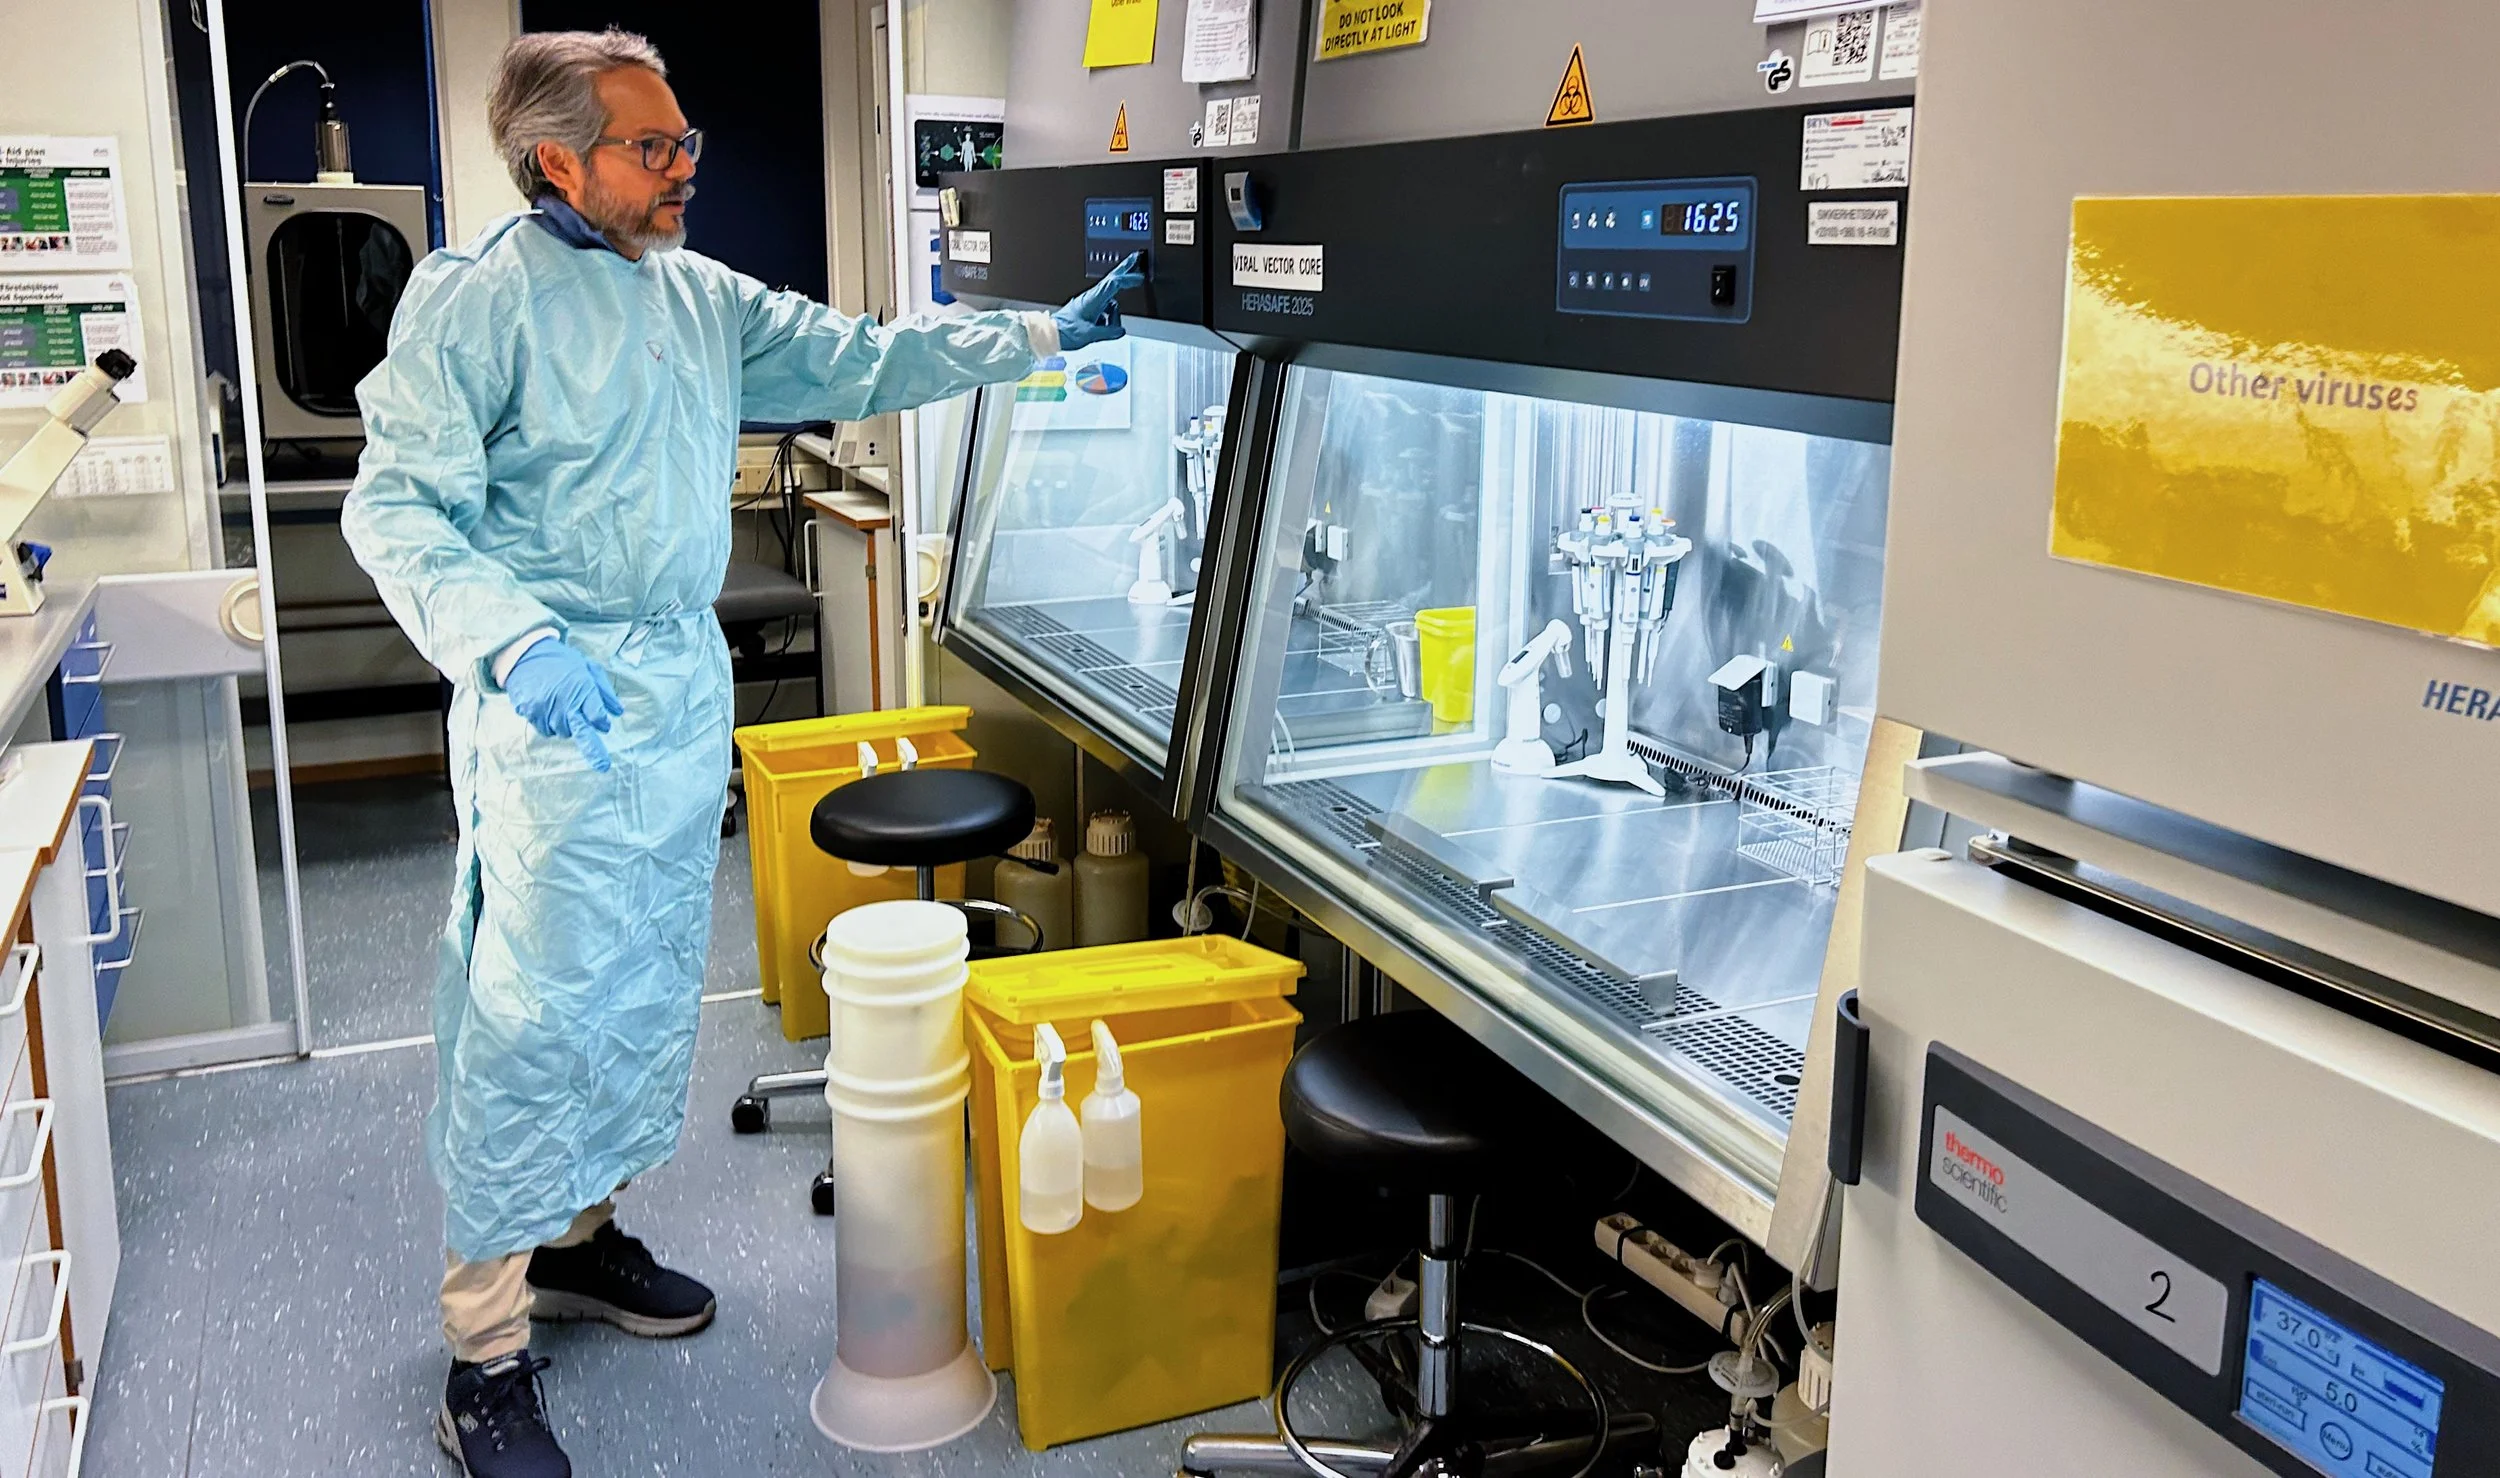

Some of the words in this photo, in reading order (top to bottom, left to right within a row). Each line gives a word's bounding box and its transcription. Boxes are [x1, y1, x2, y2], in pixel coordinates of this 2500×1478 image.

[1339, 14, 1352, 29] DO
[1353, 8, 1374, 25] NOT
[1375, 1, 1404, 21] LOOK
[1325, 30, 1369, 52] DIRECTLY
[1370, 26, 1384, 42] AT
[1385, 20, 1417, 40] LIGHT
[1129, 212, 1149, 231] 1625
[1684, 201, 1740, 233] 1625
[1233, 255, 1258, 272] VIRAL
[1263, 256, 1295, 275] VECTOR
[1299, 257, 1322, 275] CORE
[1241, 291, 1291, 314] HERASAFE
[1291, 296, 1314, 316] 2025
[2189, 362, 2287, 401] Other
[2296, 370, 2419, 412] viruses
[1945, 1130, 2005, 1185] thermo
[1942, 1156, 2008, 1214] scientific
[2145, 1270, 2176, 1324] 2
[2276, 1310, 2321, 1350] 37.0
[2325, 1380, 2358, 1414] 5.0
